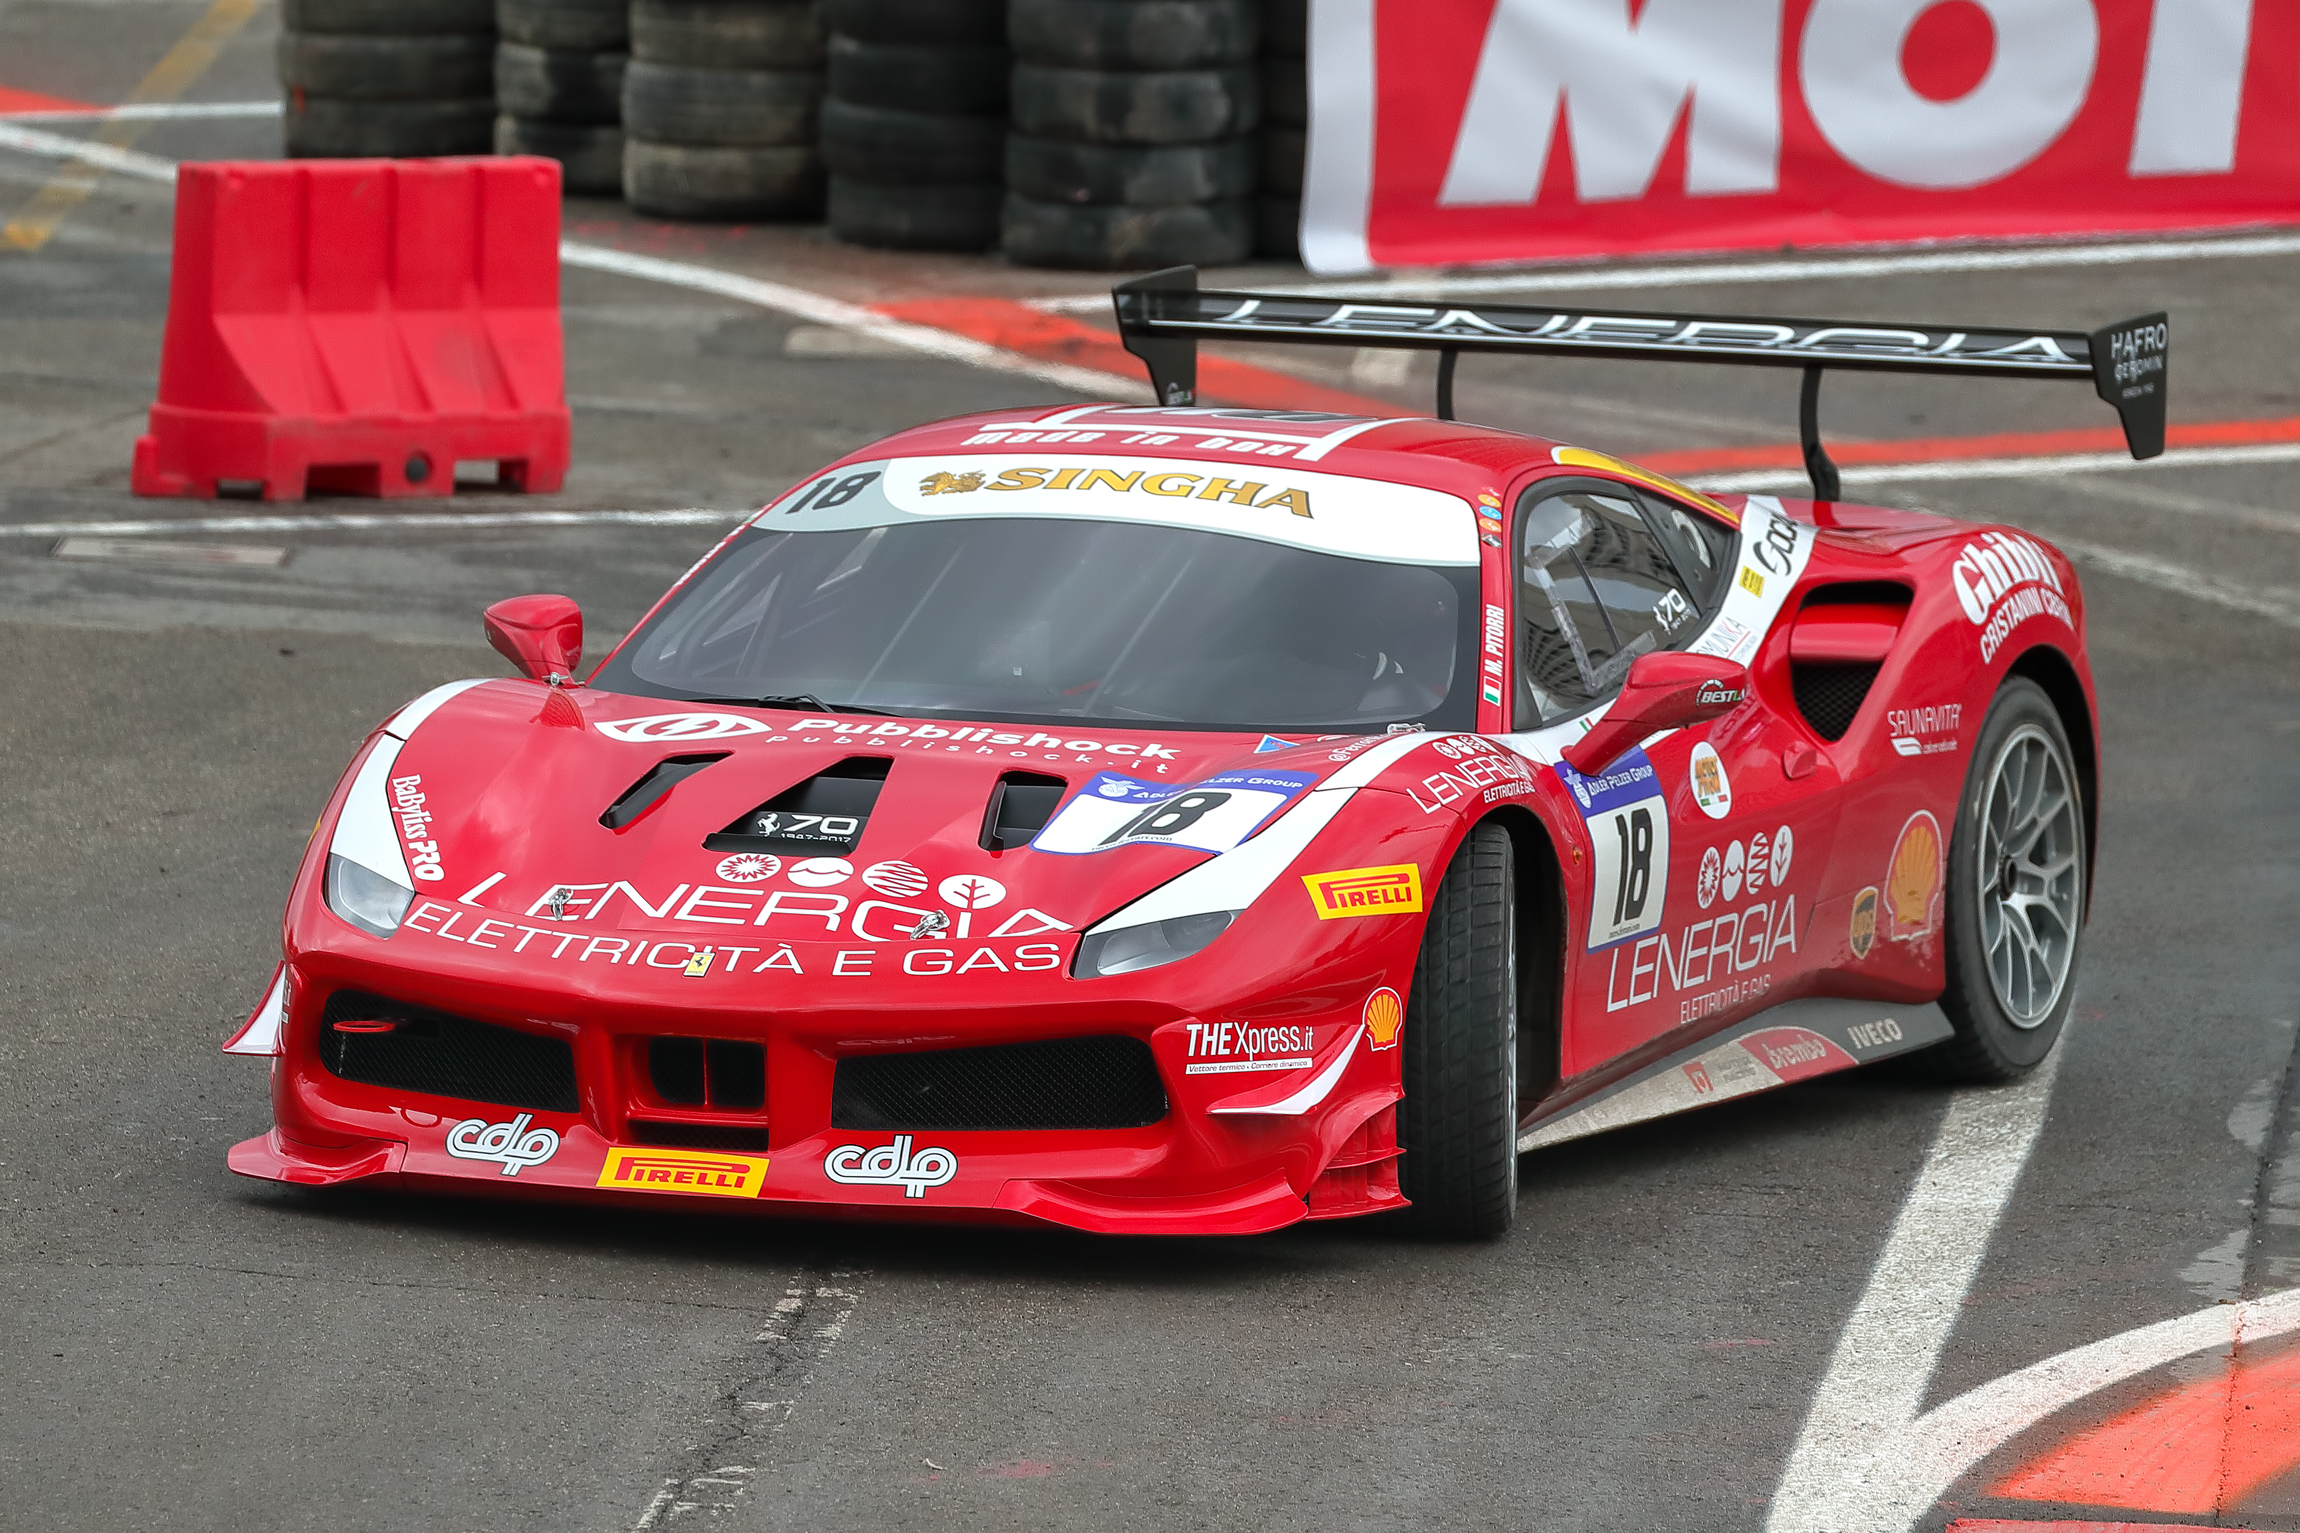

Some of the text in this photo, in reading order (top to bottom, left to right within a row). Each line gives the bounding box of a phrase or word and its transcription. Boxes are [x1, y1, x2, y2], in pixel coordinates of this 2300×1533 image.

[2110, 322, 2168, 360] HAFRO
[1119, 431, 1181, 447] in
[784, 470, 882, 515] 18
[983, 467, 1315, 519] SINGHA
[1485, 603, 1505, 657] PITORRI
[786, 718, 1181, 760] Pubblishock
[1247, 777, 1304, 789] GROUP
[783, 814, 859, 835] 70
[1097, 791, 1233, 847] 18
[407, 839, 445, 882] PRO
[1611, 807, 1653, 928] 18
[456, 870, 1075, 942] LENERGIA
[1317, 872, 1413, 910] PIRELLI
[402, 901, 1062, 977] ELETTRICTÀ E GAS
[1606, 893, 1798, 1013] LENERGIA
[1760, 1034, 1828, 1070] brembo
[1847, 1016, 1904, 1049] IVECO
[613, 1156, 751, 1189] PIRELLI
